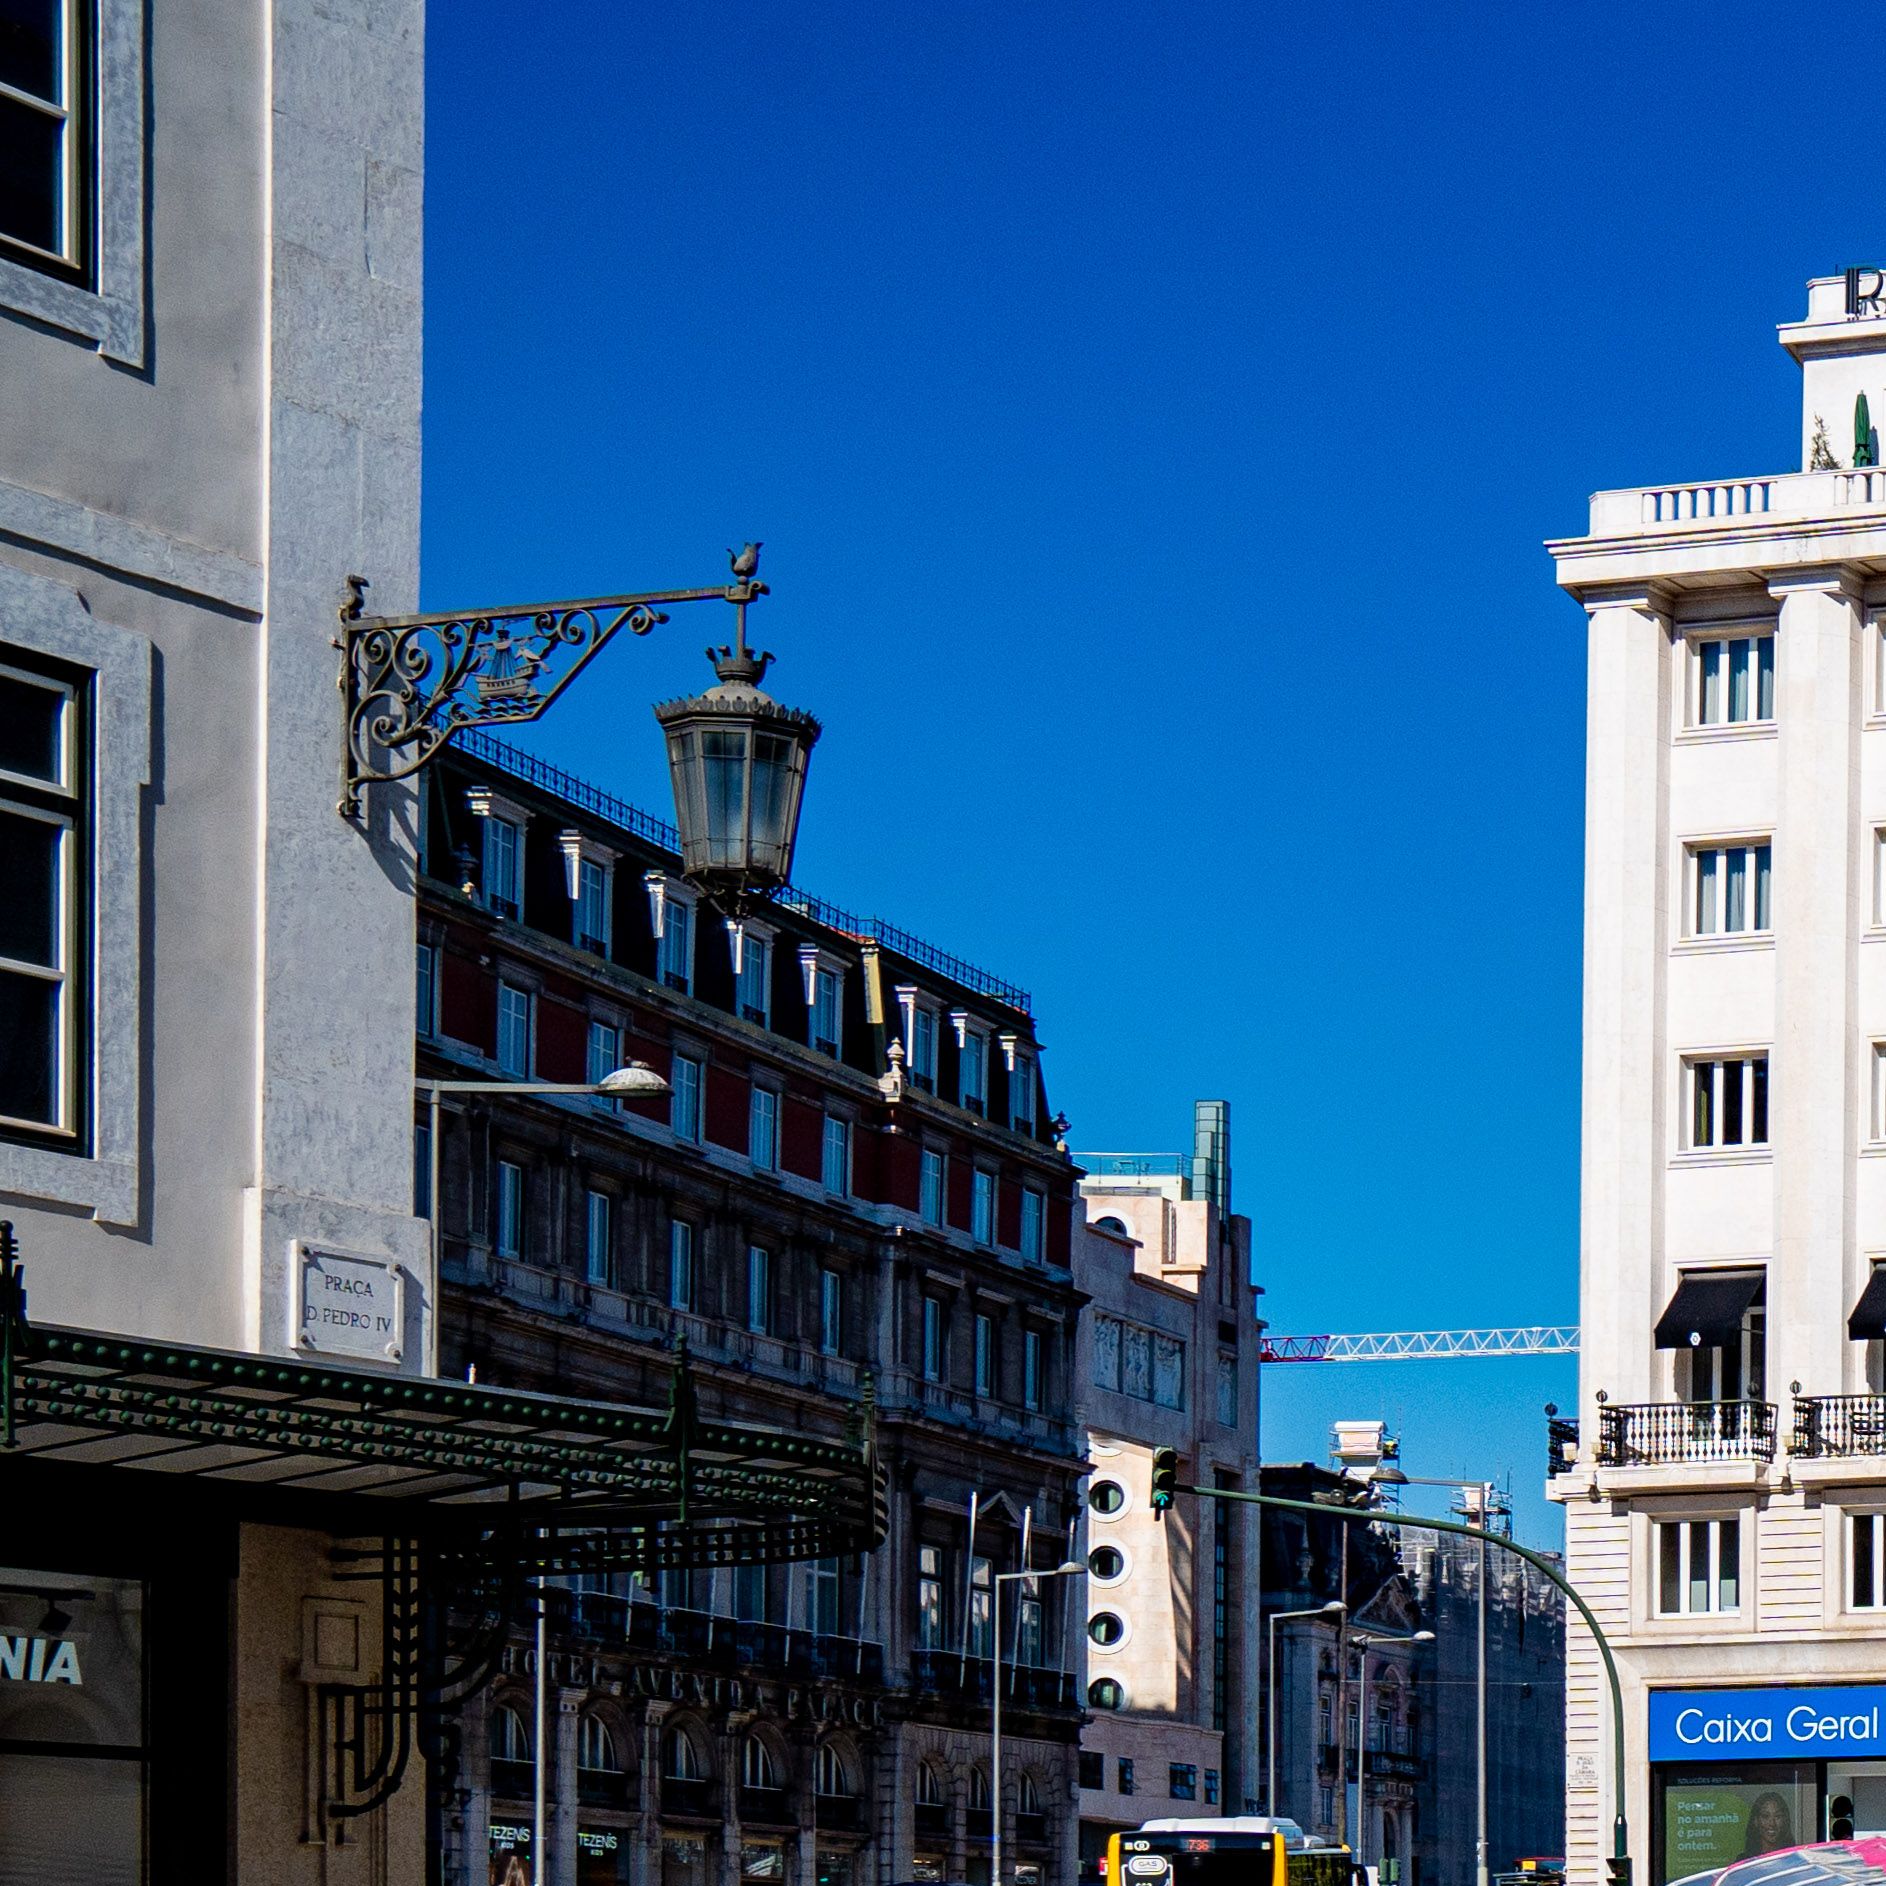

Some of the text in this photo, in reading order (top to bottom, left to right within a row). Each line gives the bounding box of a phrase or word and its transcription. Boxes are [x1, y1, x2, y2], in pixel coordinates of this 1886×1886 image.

[325, 1274, 375, 1298] PRAÇA
[306, 1305, 392, 1332] D. PEDRO IV
[1675, 1708, 1772, 1744] Caixa
[1786, 1706, 1878, 1742] Geral
[1677, 1801, 1716, 1812] Pensar
[1678, 1812, 1739, 1825] no amanhã
[1687, 1828, 1713, 1840] para
[1187, 1839, 1210, 1852] 736
[1677, 1841, 1718, 1851] ontem.
